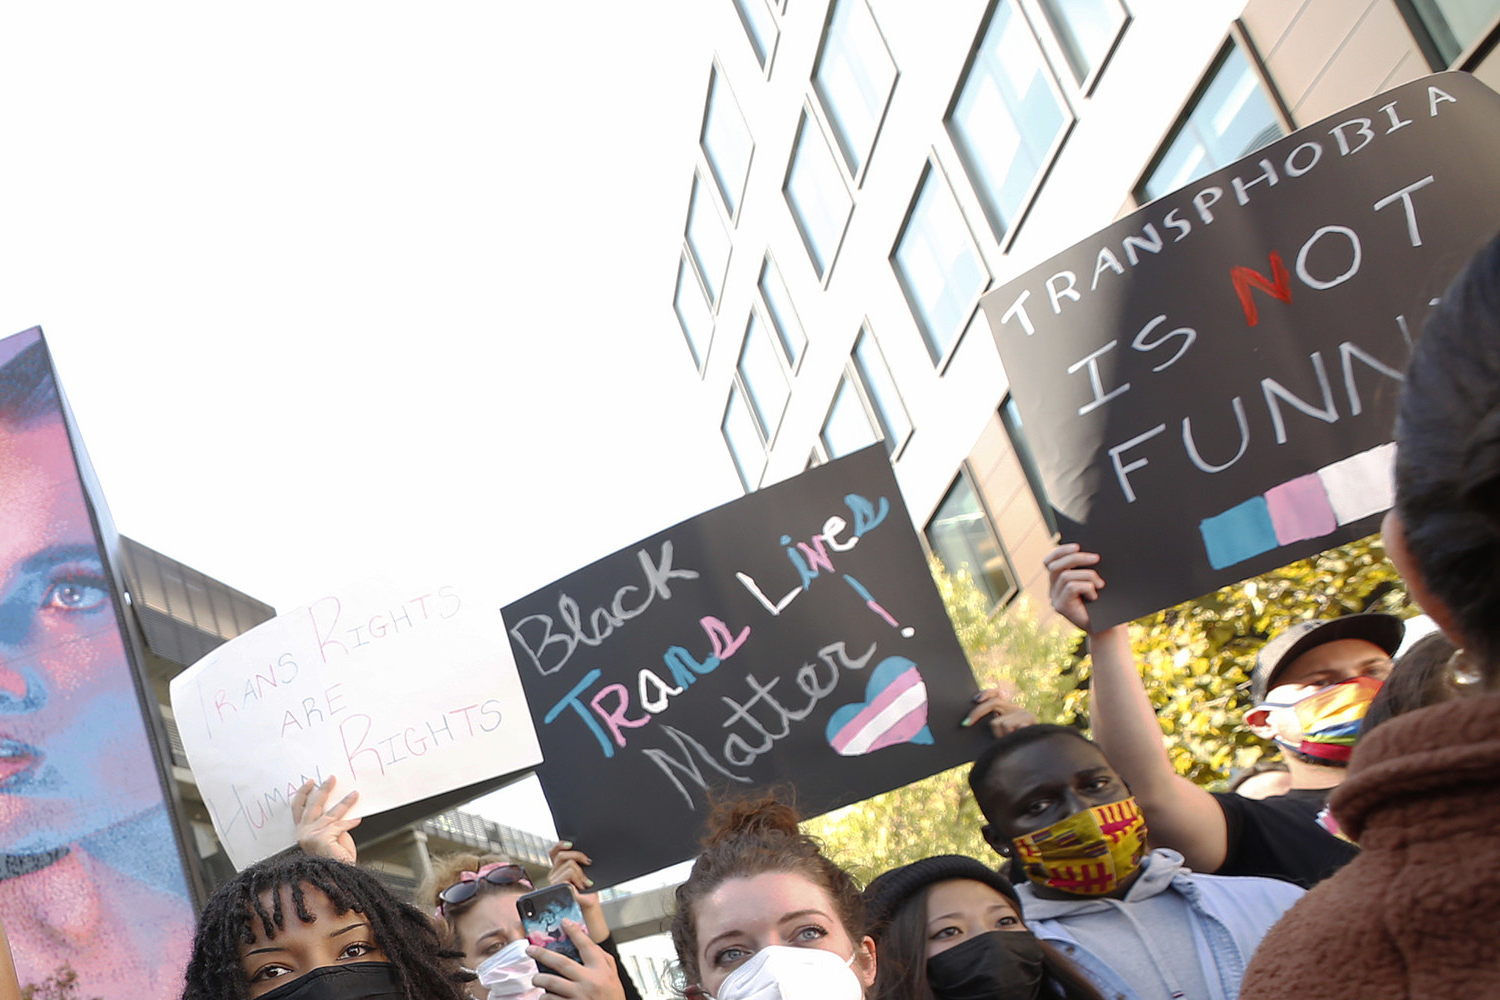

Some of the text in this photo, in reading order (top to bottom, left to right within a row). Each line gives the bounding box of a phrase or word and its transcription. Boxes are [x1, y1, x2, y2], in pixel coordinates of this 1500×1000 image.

[1001, 86, 1457, 336] TRANSPHOBIA
[1067, 176, 1435, 416] IS NOT
[1108, 297, 1441, 503] FUNN
[510, 539, 700, 677] Black
[735, 492, 890, 616] Lives
[181, 585, 462, 741] TRANS RIGHTS
[281, 683, 347, 738] ARE
[339, 699, 502, 781] RIGHTS
